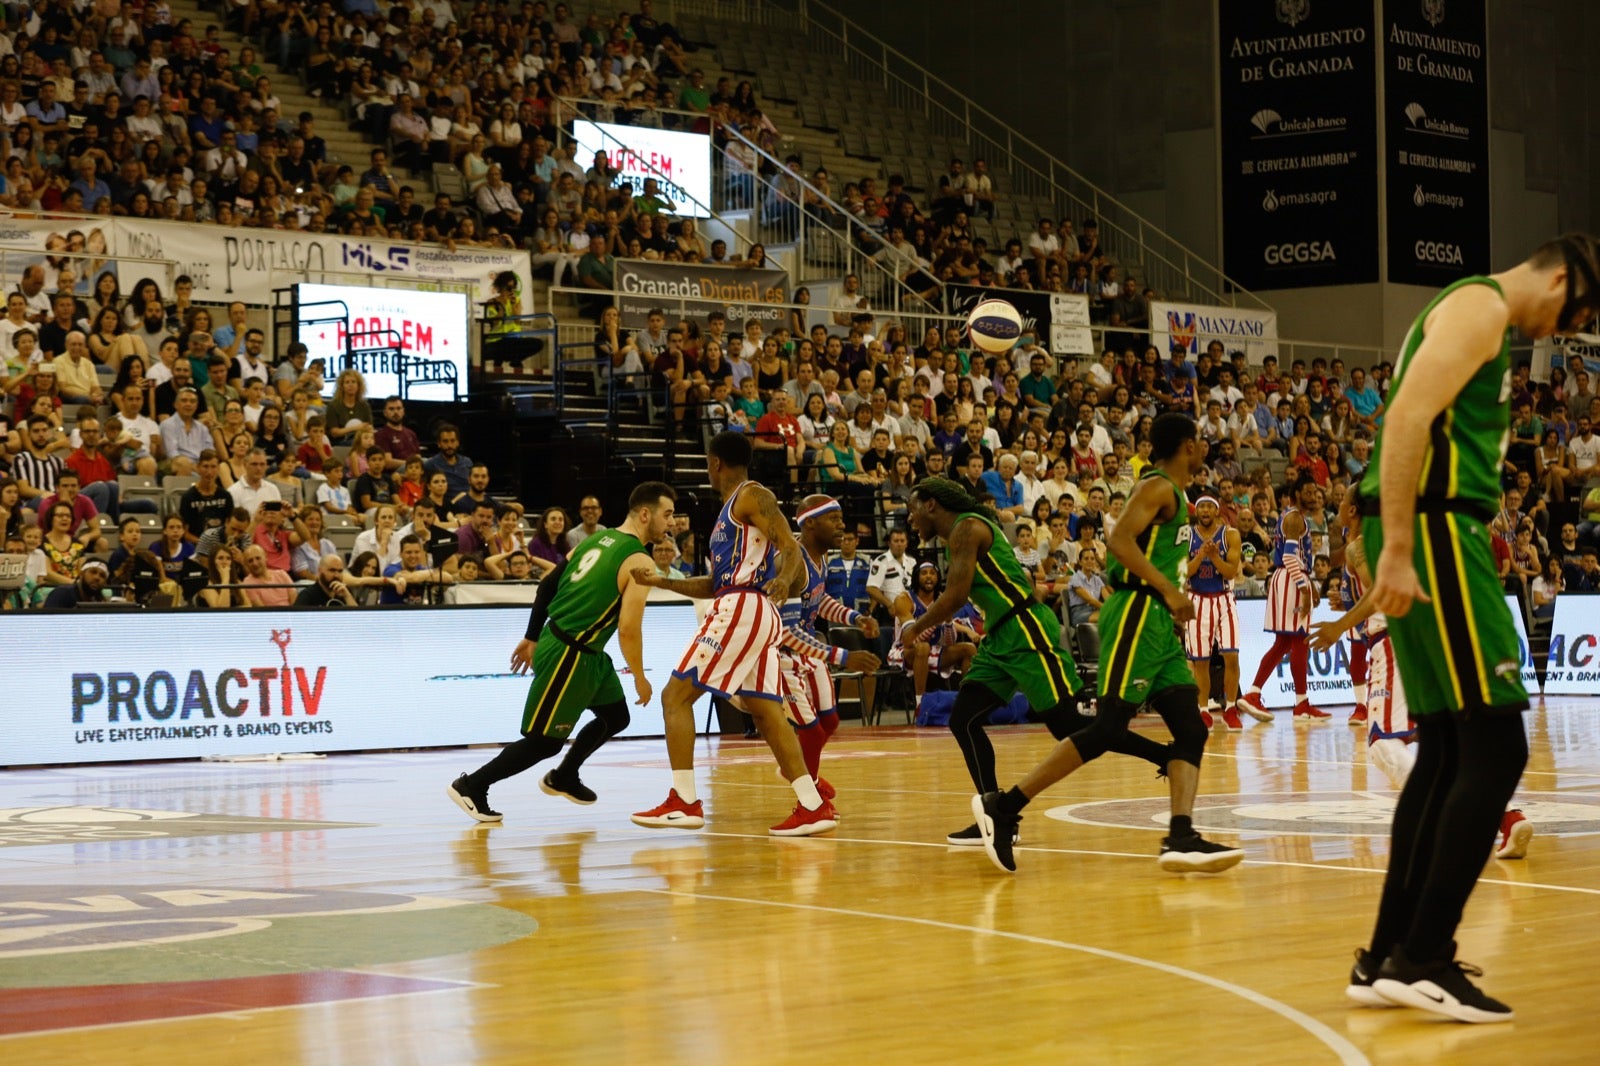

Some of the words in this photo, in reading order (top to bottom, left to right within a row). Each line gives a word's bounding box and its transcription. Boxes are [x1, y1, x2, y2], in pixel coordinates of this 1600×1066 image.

[1230, 28, 1366, 57] AYUNTAMIENTO
[1390, 22, 1481, 59] AYUNTAMIENTO
[1241, 66, 1263, 82] DE
[1269, 57, 1354, 79] GRANADA
[1397, 55, 1414, 73] DE
[1417, 53, 1473, 83] GRANADA
[1280, 117, 1316, 132] Unicaja
[1317, 117, 1347, 128] Banco
[1424, 118, 1449, 134] Unicaja
[1449, 123, 1470, 135] Banco
[1257, 157, 1299, 173] CERVEZAS
[1301, 153, 1349, 168] ALHAMBRA
[1409, 153, 1438, 169] CERVEZAS
[1439, 158, 1471, 173] ALHAMBRA
[1280, 190, 1337, 205] emasagra
[1425, 192, 1464, 208] emasagra
[337, 317, 433, 355] HARLEM
[1199, 316, 1264, 337] MANZANO
[570, 548, 602, 582] 9
[1199, 565, 1214, 578] 21
[71, 666, 328, 723] PROACTIV
[75, 728, 104, 743] LIVE
[109, 724, 219, 742] ENTERTAINMENT
[223, 724, 233, 737] &
[237, 722, 281, 737] BRAND
[285, 720, 334, 735] EVENTS
